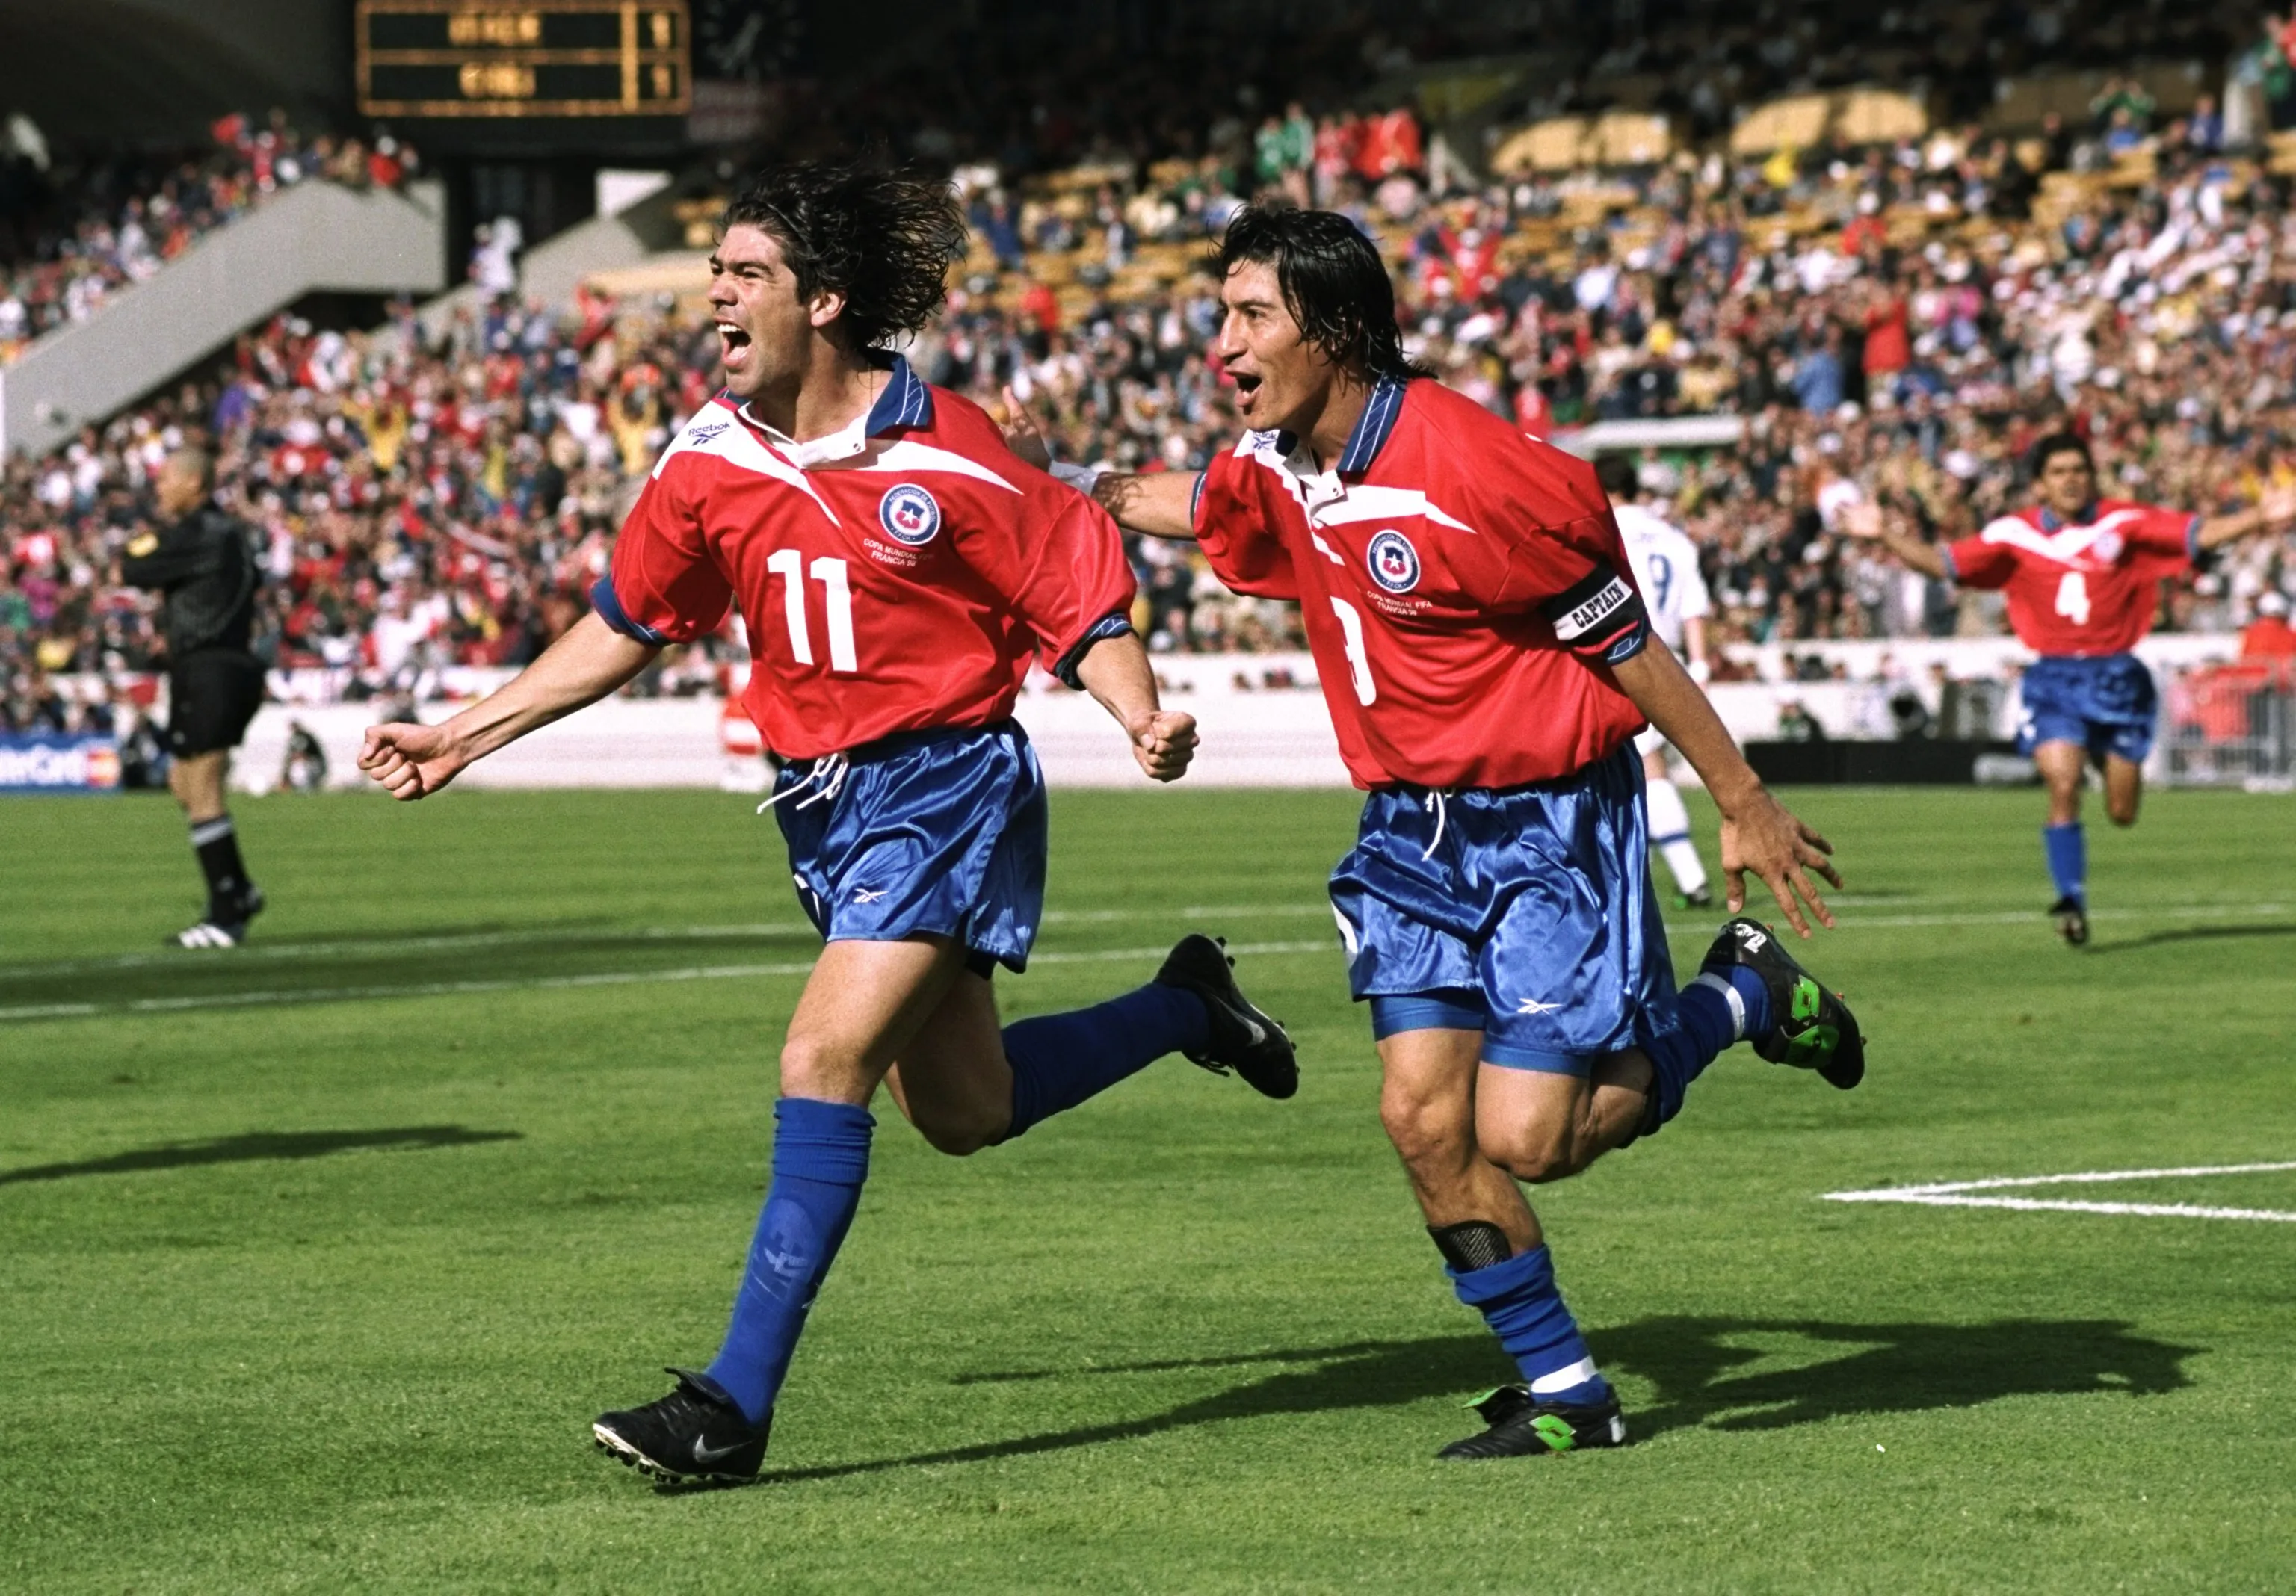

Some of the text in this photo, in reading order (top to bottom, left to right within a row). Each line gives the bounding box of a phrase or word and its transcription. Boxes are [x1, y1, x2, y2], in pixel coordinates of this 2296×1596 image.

[688, 421, 730, 436] Reebok
[863, 538, 883, 551] COPA
[884, 545, 918, 560] MUNDIAL
[871, 550, 905, 566] FRANCIA
[1367, 590, 1384, 601] COPA
[1415, 601, 1433, 609] FIFA
[1377, 601, 1408, 615] FRANCIA
[1571, 582, 1626, 628] CAPTAIN
[2054, 571, 2092, 626] 4
[767, 548, 857, 672] 11
